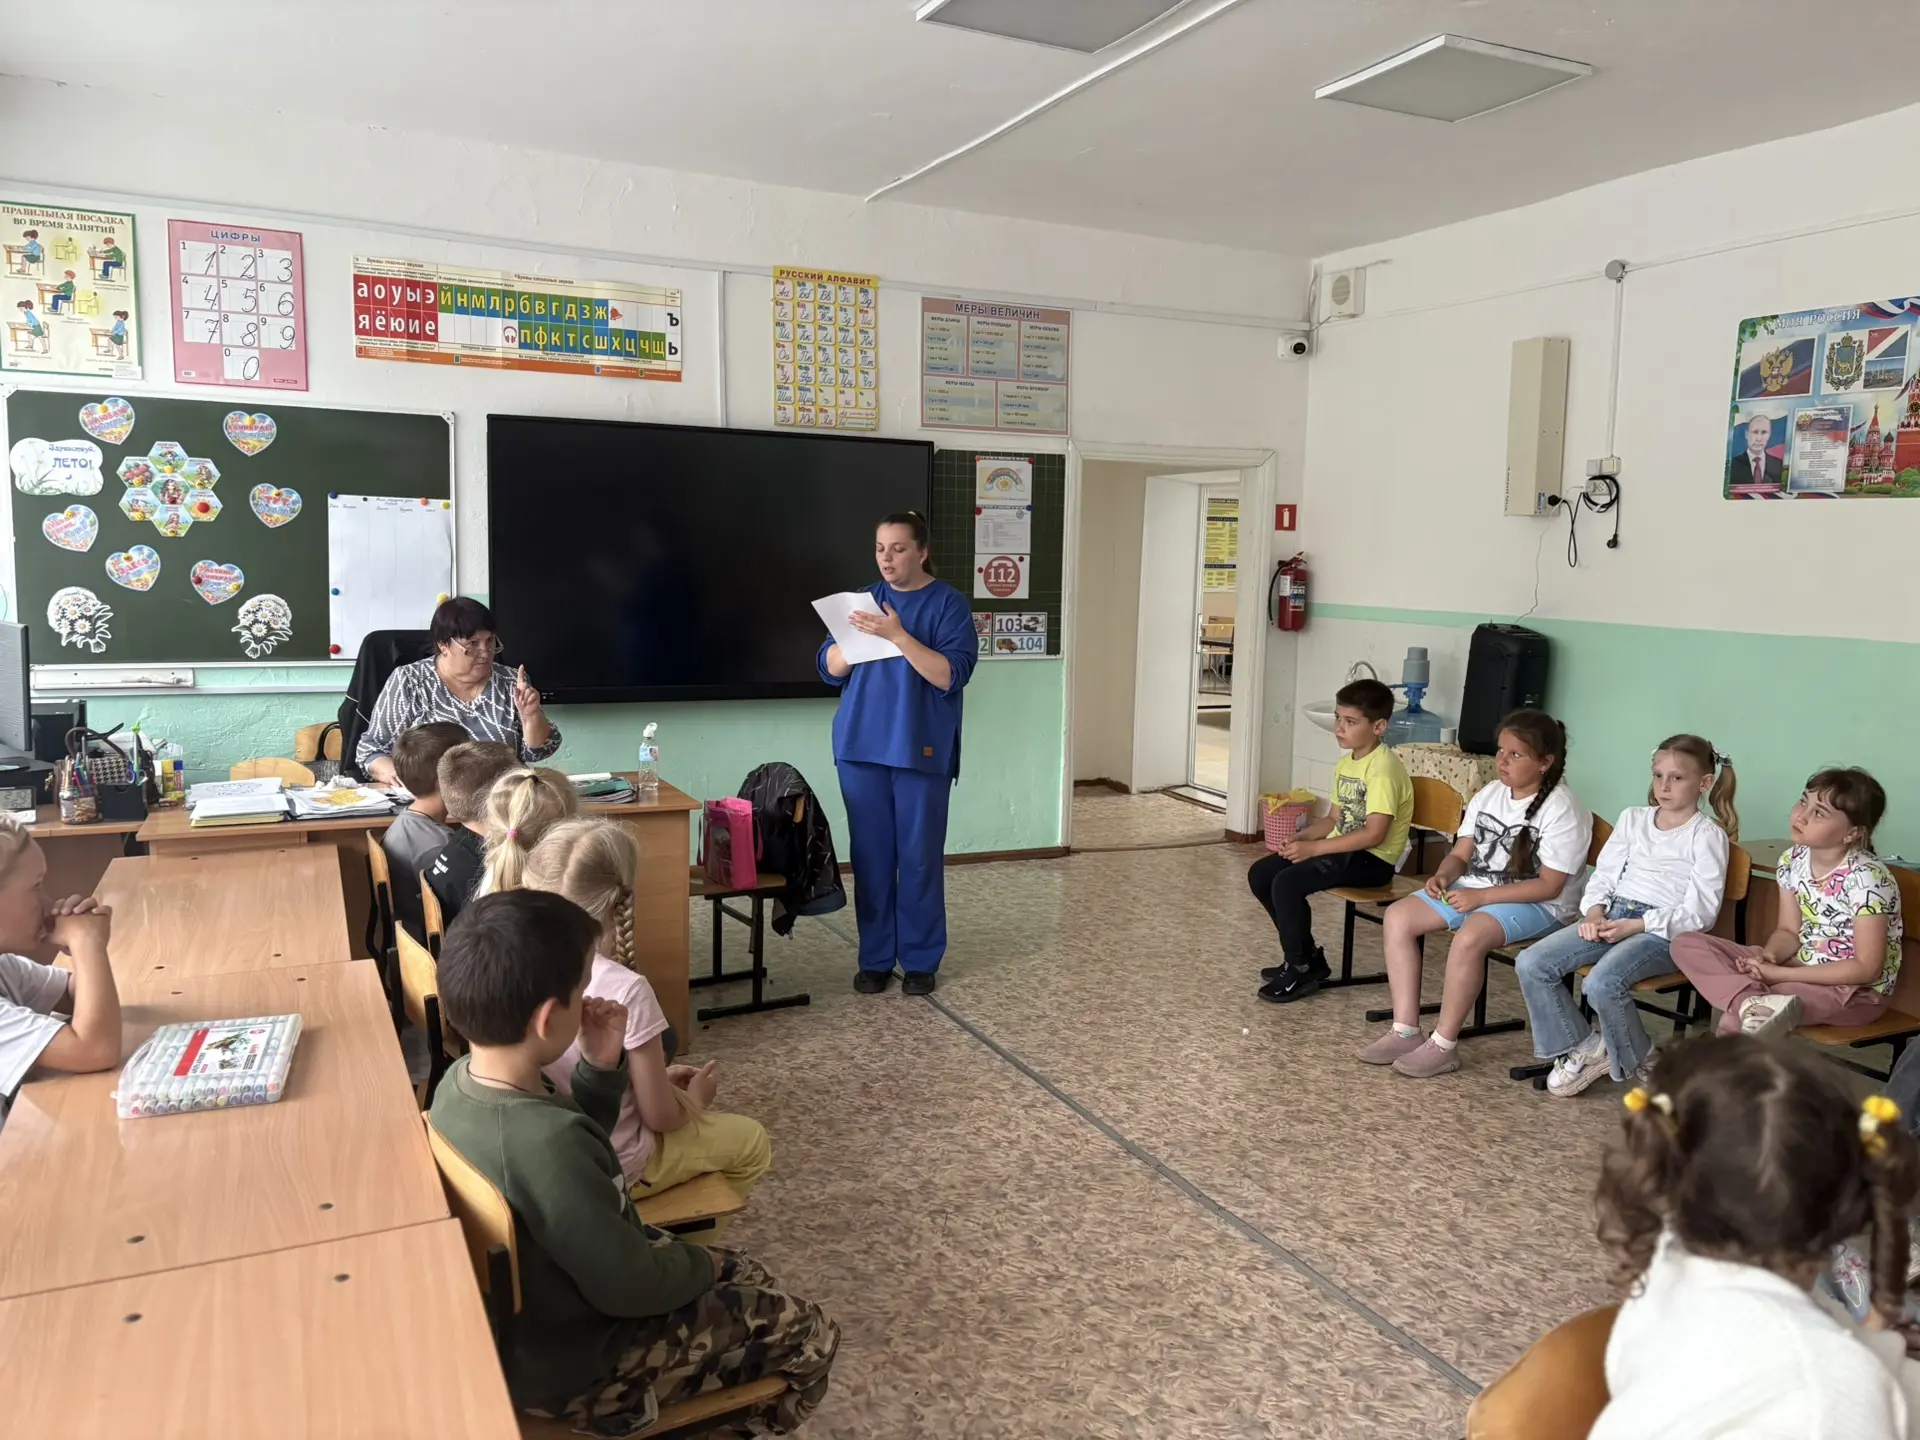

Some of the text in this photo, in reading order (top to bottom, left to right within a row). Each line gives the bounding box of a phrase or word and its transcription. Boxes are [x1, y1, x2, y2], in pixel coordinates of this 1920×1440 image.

[1, 206, 125, 225] ПРАВИЛЬНАЯ ПОСАДКА
[13, 217, 115, 234] ВО ВРЕМЯ ЗАНЯТИЙ
[211, 230, 260, 243] ЦИФРЫ
[181, 242, 187, 250] 1
[220, 245, 226, 254] 2
[258, 250, 264, 258] 3
[205, 251, 216, 275] 1
[240, 254, 256, 279] 2
[277, 258, 293, 282] 3
[182, 276, 188, 285] 4
[221, 280, 228, 288] 5
[780, 269, 872, 285] РУССКИЙ АЛФАВИТ
[259, 283, 265, 291] 6
[204, 284, 218, 309] 4
[241, 288, 256, 313] 5
[278, 292, 294, 316] 6
[183, 311, 190, 319] 7
[223, 314, 229, 322] 8
[955, 303, 1040, 319] МЕРЫ ВЕЛИЧИН
[1775, 308, 1860, 330] МОЯ РОССИЯ
[260, 317, 266, 325] 9
[205, 319, 220, 344] 7
[242, 322, 258, 346] 8
[280, 325, 295, 350] 9
[224, 348, 231, 357] 0
[243, 356, 259, 380] 0
[988, 568, 1016, 583] 112
[996, 618, 1022, 632] 103
[1018, 637, 1043, 651] 104
